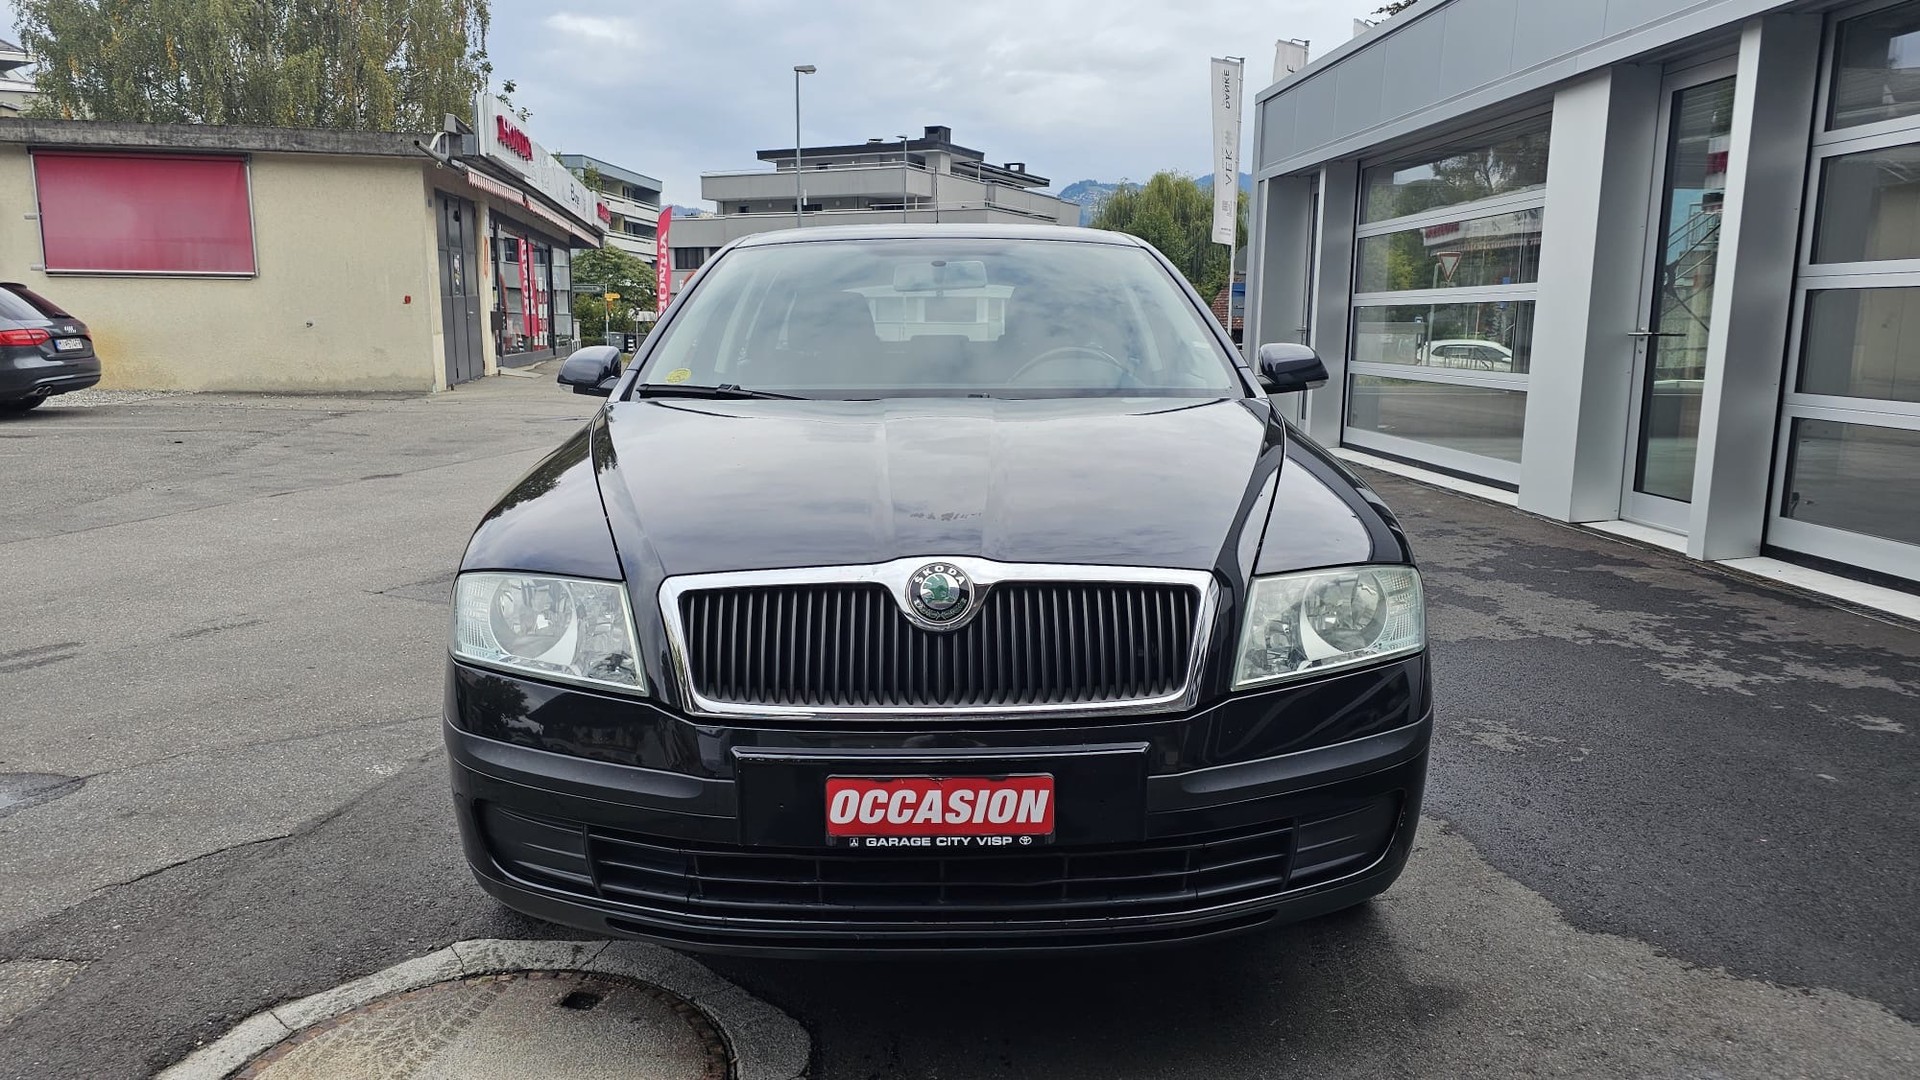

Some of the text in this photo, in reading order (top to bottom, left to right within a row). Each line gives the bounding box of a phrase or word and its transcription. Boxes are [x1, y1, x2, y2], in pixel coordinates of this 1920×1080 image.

[829, 788, 1050, 825] OCCASION
[865, 836, 1013, 847] GARAGE CITY VISP
